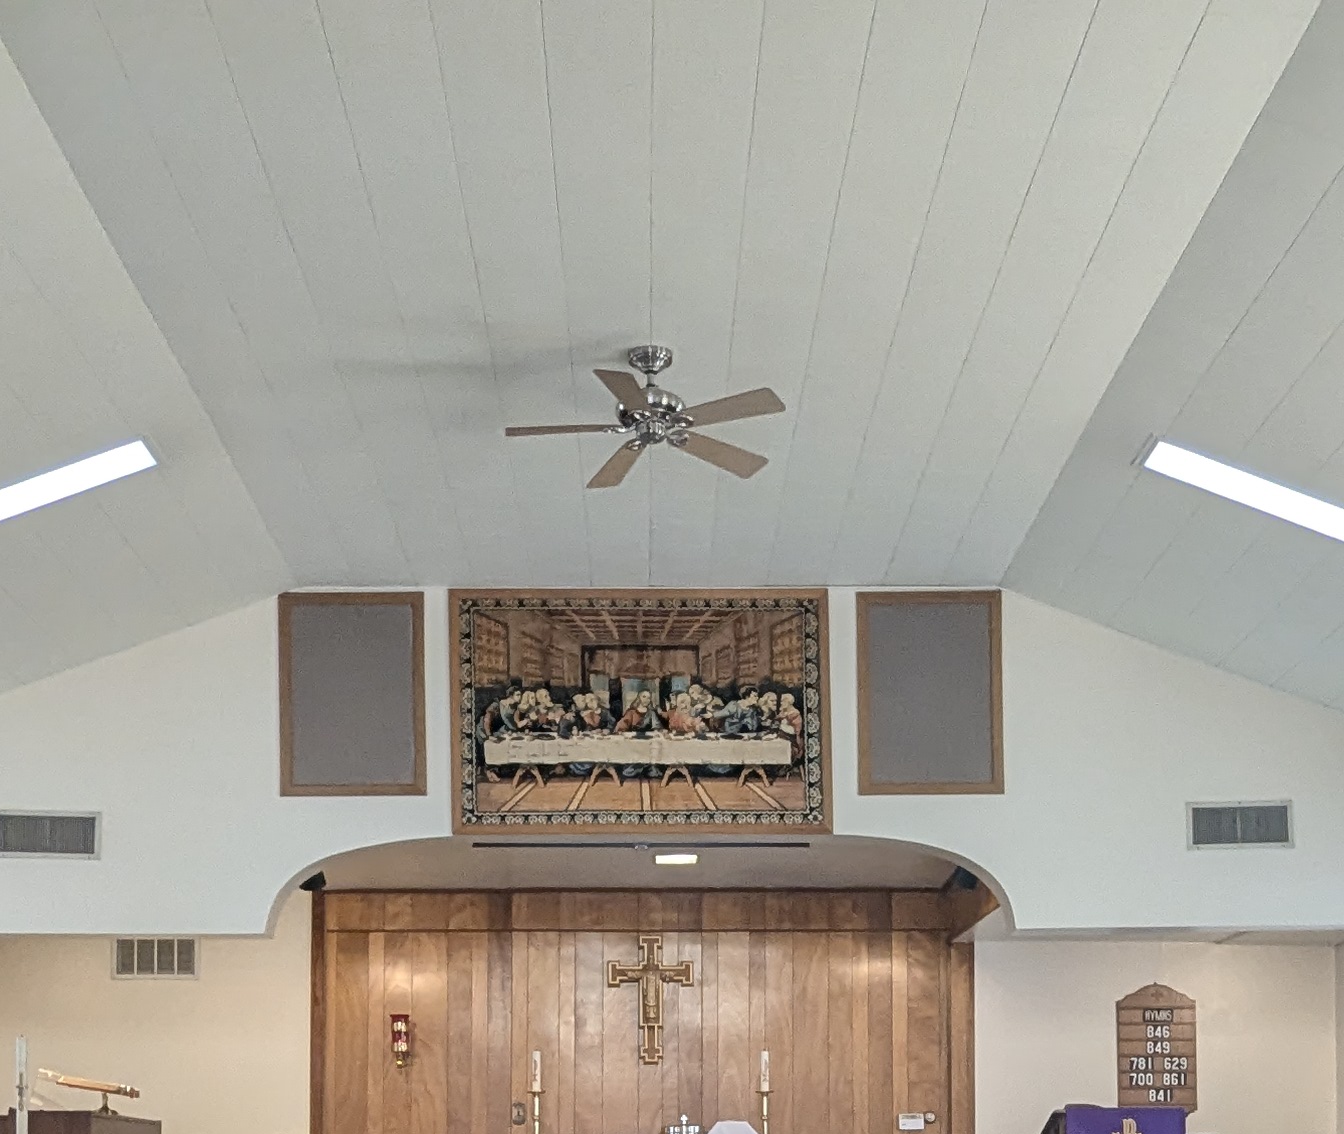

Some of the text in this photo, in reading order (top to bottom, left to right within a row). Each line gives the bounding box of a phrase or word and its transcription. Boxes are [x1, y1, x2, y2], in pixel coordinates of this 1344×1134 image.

[1147, 1026, 1170, 1038] 846
[1147, 1042, 1170, 1054] 849
[1129, 1057, 1188, 1070] 781 629
[1129, 1073, 1185, 1086] 700 861
[1149, 1089, 1171, 1102] 841
